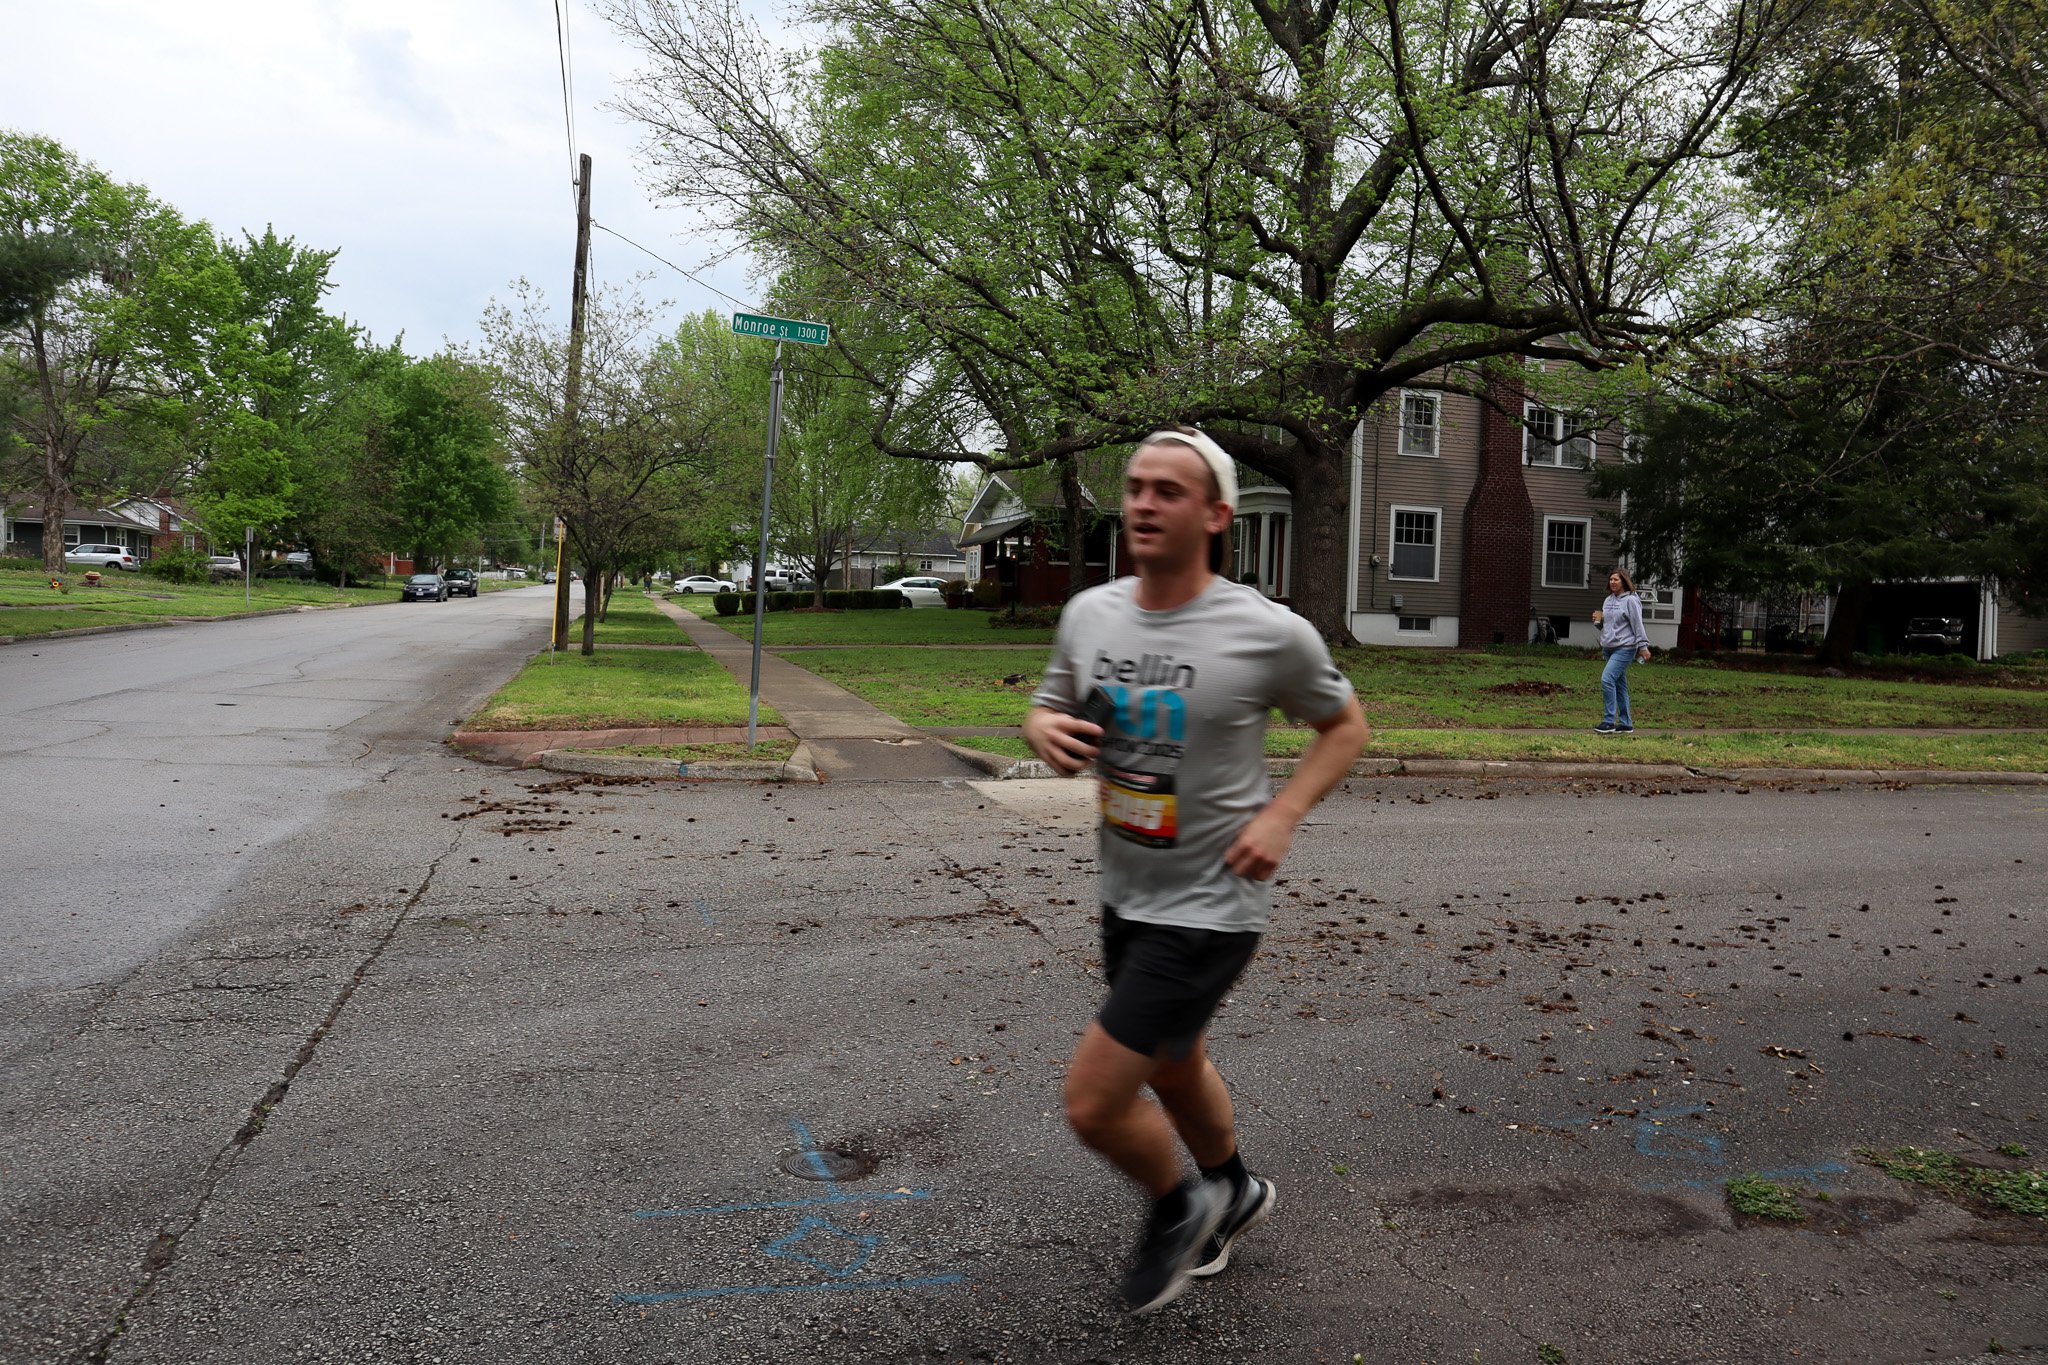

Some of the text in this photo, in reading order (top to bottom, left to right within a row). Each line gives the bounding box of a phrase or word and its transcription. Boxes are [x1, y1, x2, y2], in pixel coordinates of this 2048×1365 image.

[735, 315, 826, 341] Monroe St 1300 E
[1091, 648, 1197, 689] bellin
